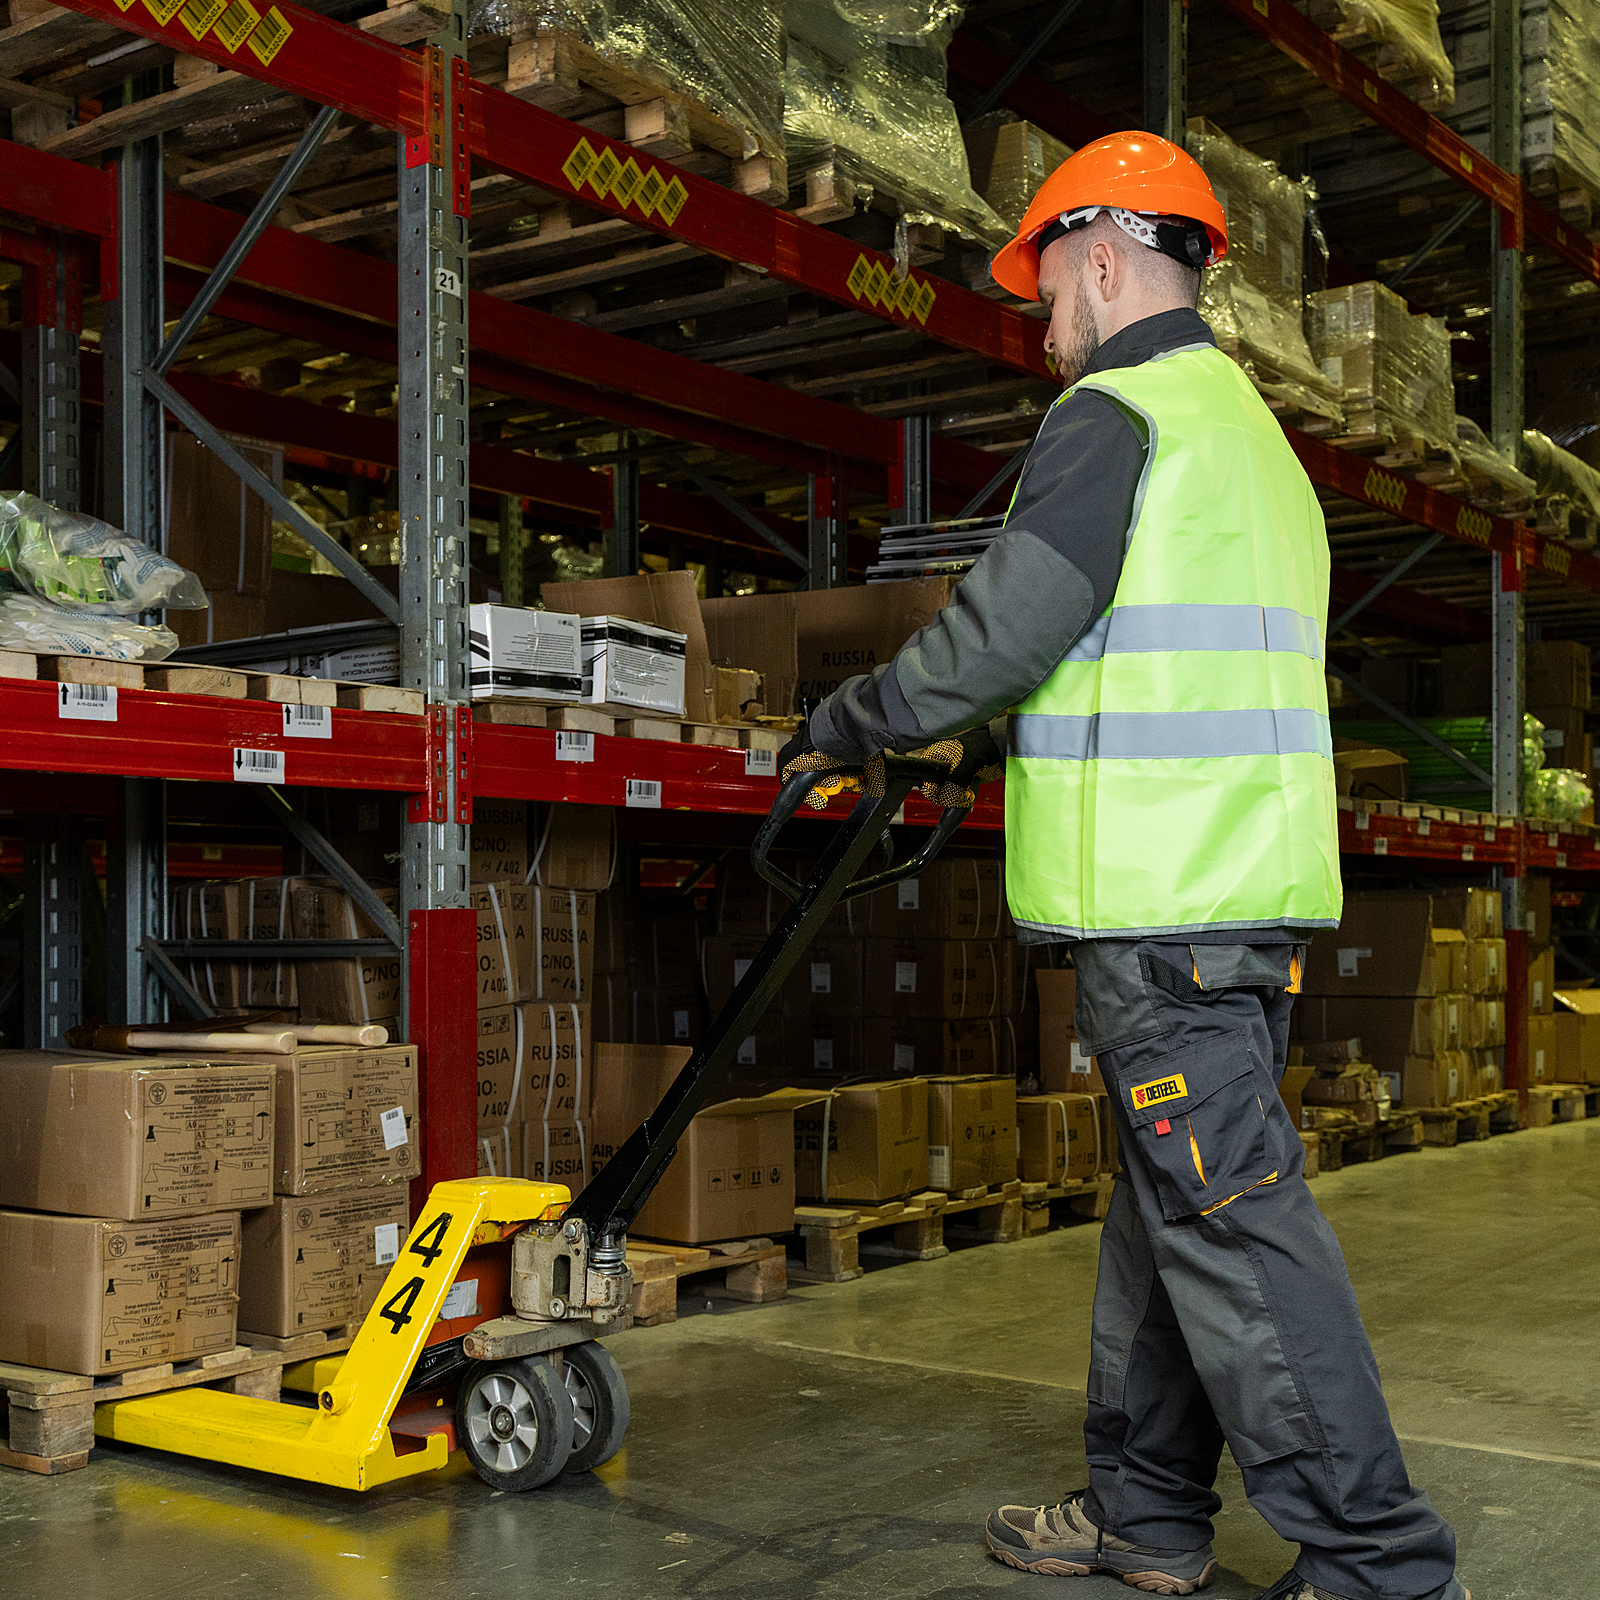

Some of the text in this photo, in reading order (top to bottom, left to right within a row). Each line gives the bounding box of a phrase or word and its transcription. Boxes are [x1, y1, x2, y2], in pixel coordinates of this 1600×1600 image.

[440, 272, 454, 290] 21
[822, 650, 876, 666] RUSSIA
[474, 808, 524, 824] RUSSIA
[472, 836, 510, 852] C/NO:
[542, 927, 588, 943] RUSSA
[563, 978, 585, 992] /42
[532, 1044, 584, 1060] RUSSI
[1146, 1080, 1182, 1102] DENZEL
[557, 1096, 574, 1109] /40
[592, 1144, 613, 1158] AIR
[409, 1212, 454, 1268] 4
[380, 1277, 425, 1334] 4
[142, 1317, 150, 1325] М
[141, 1347, 148, 1355] К
